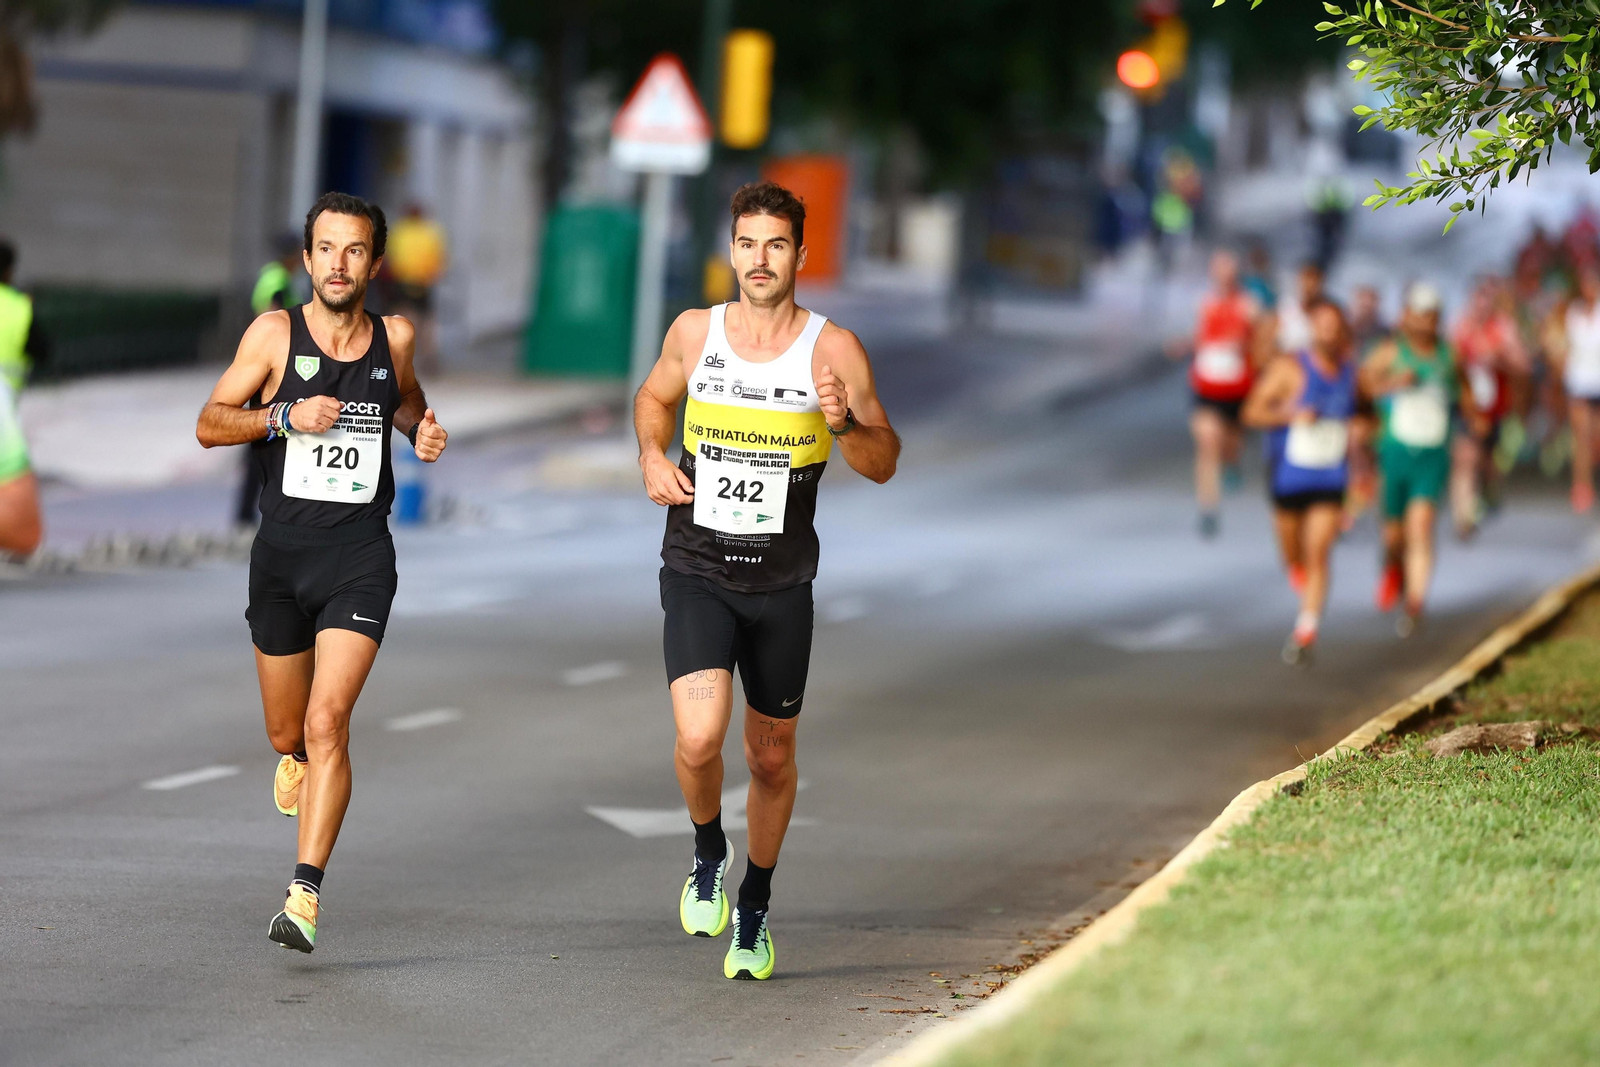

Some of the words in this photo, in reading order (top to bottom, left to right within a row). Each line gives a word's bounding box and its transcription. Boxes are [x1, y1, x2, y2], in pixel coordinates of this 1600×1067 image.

[705, 427, 768, 445] TRIATLÓN
[770, 434, 817, 448] MÁLAGA
[312, 444, 359, 470] 120
[700, 443, 722, 462] 43
[722, 455, 744, 464] CIUDAD
[723, 448, 757, 459] CARRERA
[758, 452, 790, 460] URBANA
[717, 477, 764, 503] 242
[723, 539, 747, 548] Divino
[688, 686, 715, 700] RIDE
[759, 734, 785, 747] LIVE
